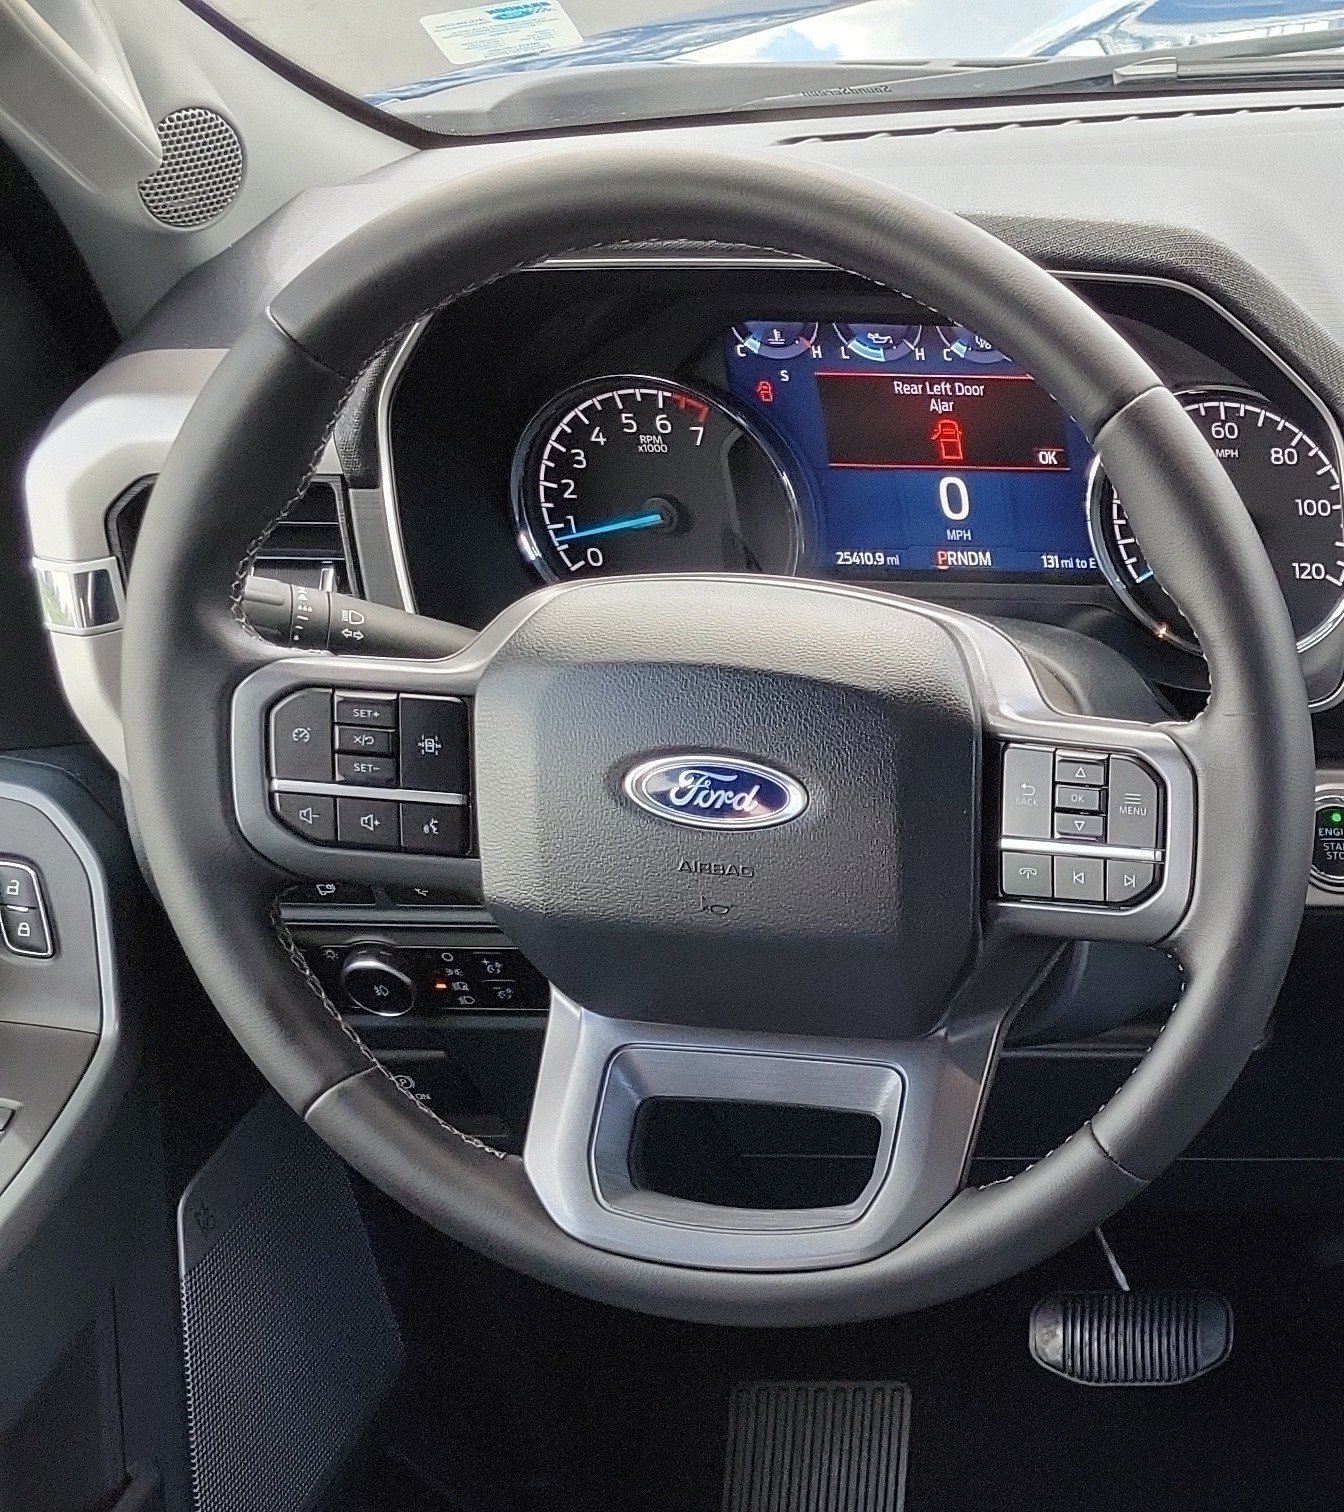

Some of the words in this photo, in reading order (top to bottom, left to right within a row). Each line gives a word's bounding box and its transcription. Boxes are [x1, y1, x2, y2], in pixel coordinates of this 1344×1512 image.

[737, 345, 746, 358] C
[812, 346, 823, 359] H
[841, 347, 849, 360] L
[915, 348, 925, 361] H
[943, 348, 952, 361] C
[780, 370, 789, 382] S
[894, 381, 923, 395] Rear
[927, 382, 952, 395] Left
[954, 383, 985, 397] Door
[929, 399, 954, 413] Ajar
[621, 414, 637, 433] 5
[656, 414, 672, 434] 6
[1211, 422, 1239, 439] 60
[590, 427, 606, 445] 4
[640, 435, 663, 444] RPM
[689, 427, 704, 446] 7
[638, 443, 668, 453] x1000
[1216, 449, 1239, 458] MPH
[572, 450, 586, 468] 3
[1038, 451, 1058, 465] OK
[1270, 448, 1298, 465] 80
[560, 480, 577, 498] 2
[938, 476, 970, 521] 0
[1295, 499, 1331, 516] 100
[947, 529, 972, 542] MPH
[587, 547, 603, 567] 0
[836, 552, 884, 566] 25410.9
[886, 554, 900, 566] mi
[1041, 555, 1060, 569] 131
[1061, 557, 1073, 569] mi
[1075, 557, 1088, 569] to
[1292, 563, 1325, 580] 120
[669, 769, 760, 812] Ford
[1070, 794, 1084, 804] OK
[1119, 806, 1147, 817] MENU
[677, 860, 755, 877] AIRBAG
